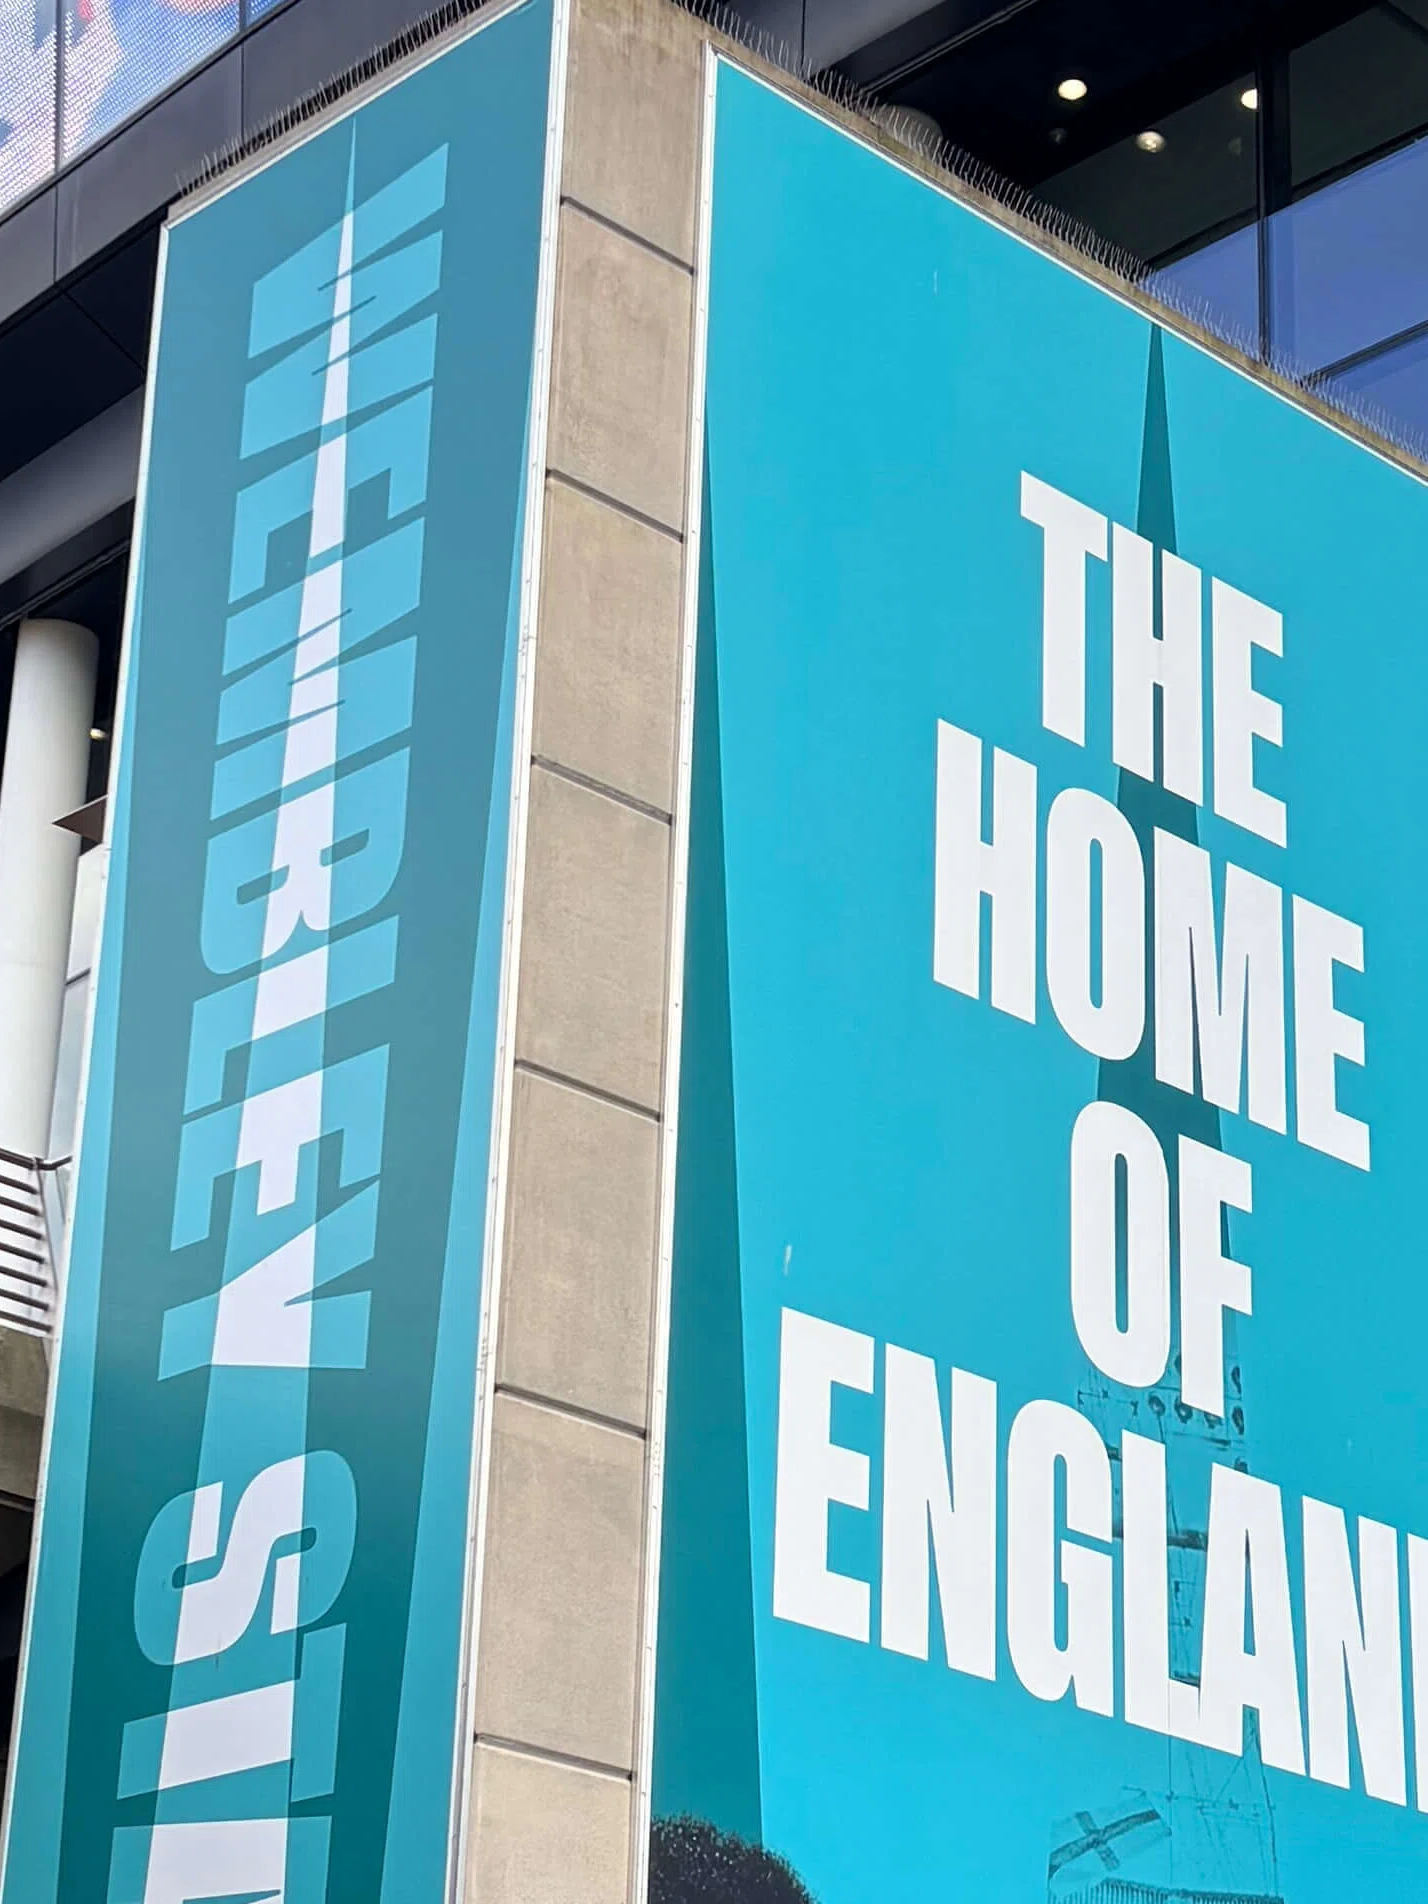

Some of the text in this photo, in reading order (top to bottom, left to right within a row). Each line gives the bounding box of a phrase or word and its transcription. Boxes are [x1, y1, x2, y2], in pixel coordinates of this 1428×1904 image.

[156, 141, 450, 1383] WEMBLEY
[1018, 470, 1289, 848] THE
[932, 716, 1371, 1173] HOME
[1069, 1099, 1254, 1419] OF
